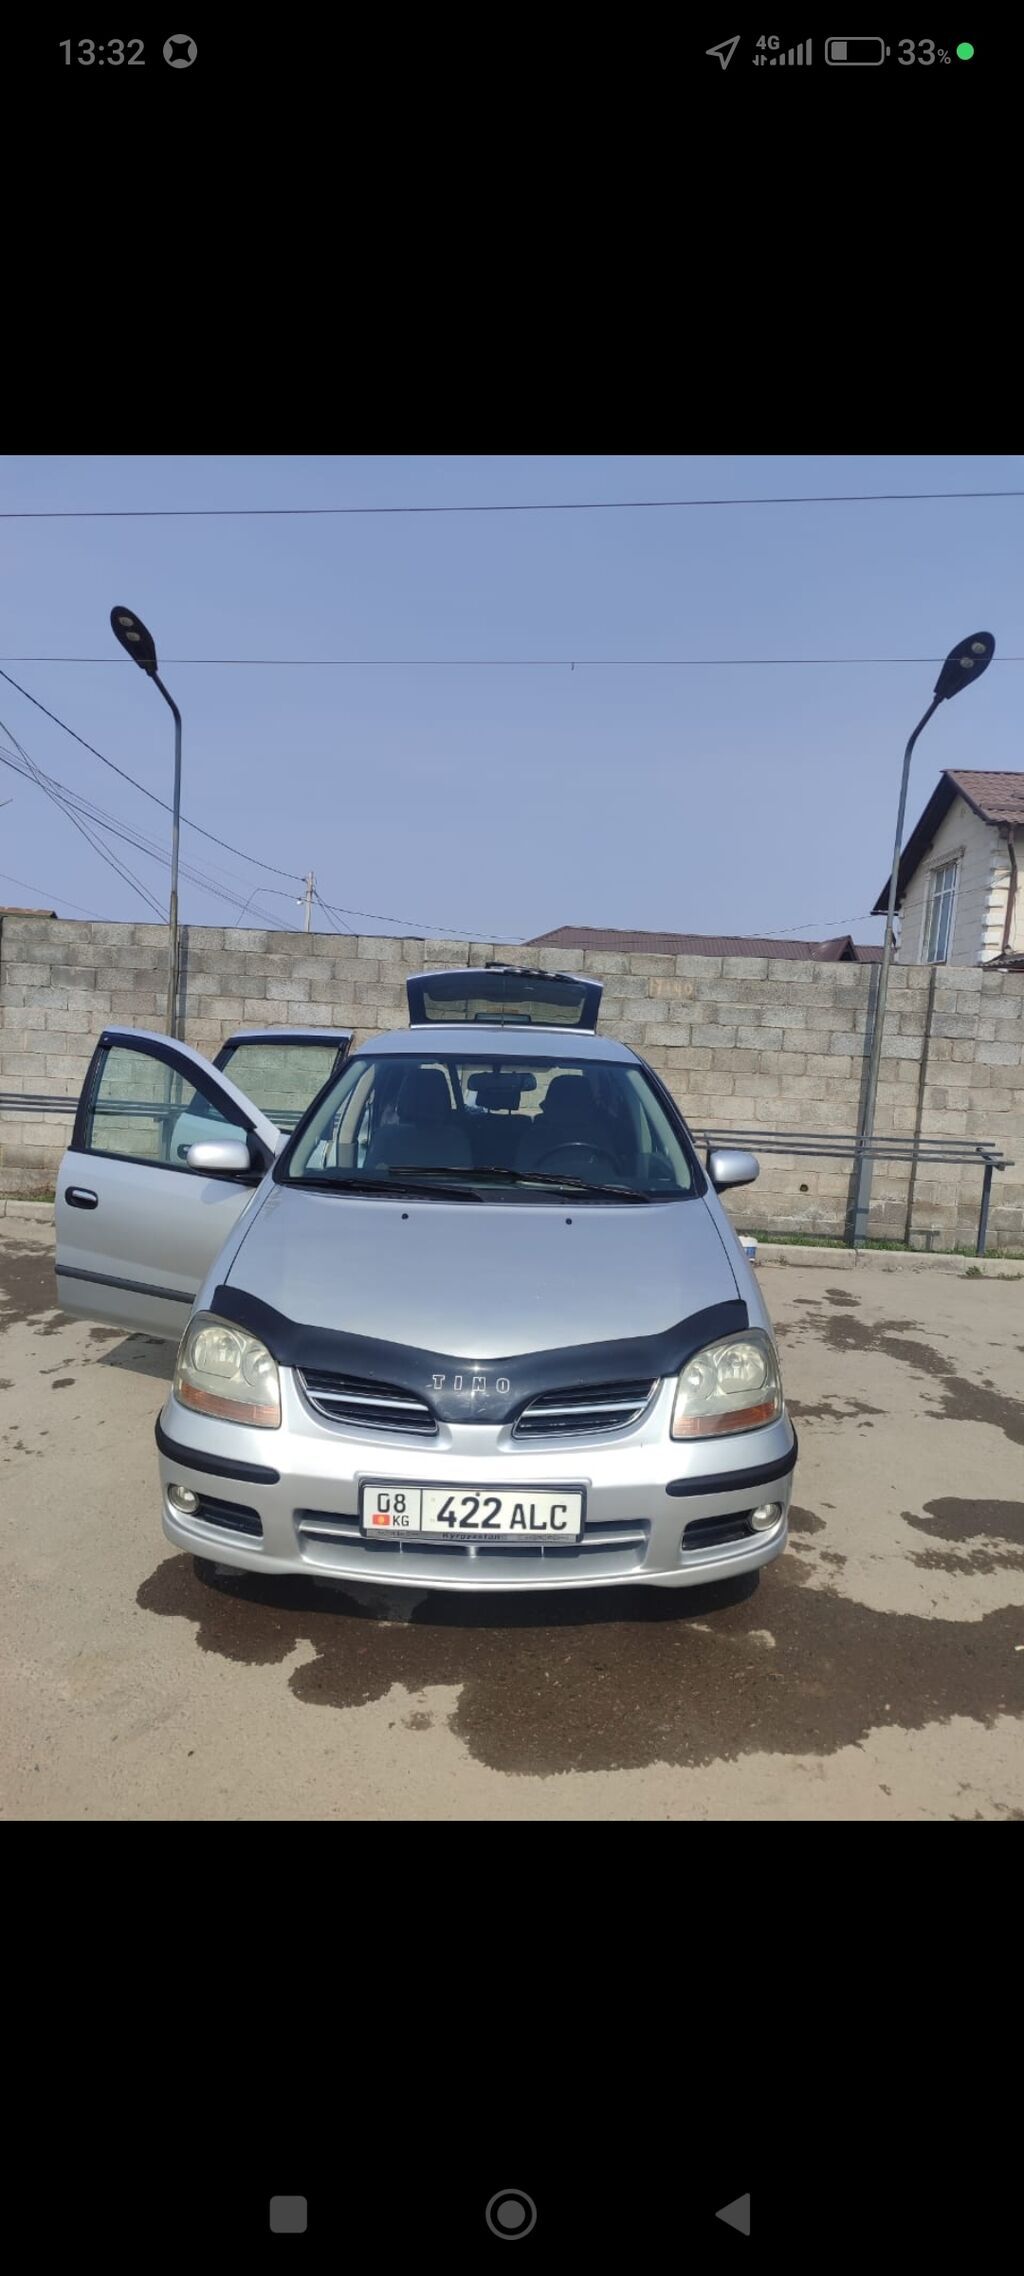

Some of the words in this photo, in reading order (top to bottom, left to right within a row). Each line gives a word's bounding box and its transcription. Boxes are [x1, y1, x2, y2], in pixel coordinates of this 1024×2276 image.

[432, 1374, 511, 1394] TINO
[377, 1492, 406, 1514] 08
[436, 1495, 502, 1530] 422
[509, 1502, 568, 1531] ALC
[392, 1514, 410, 1527] KG
